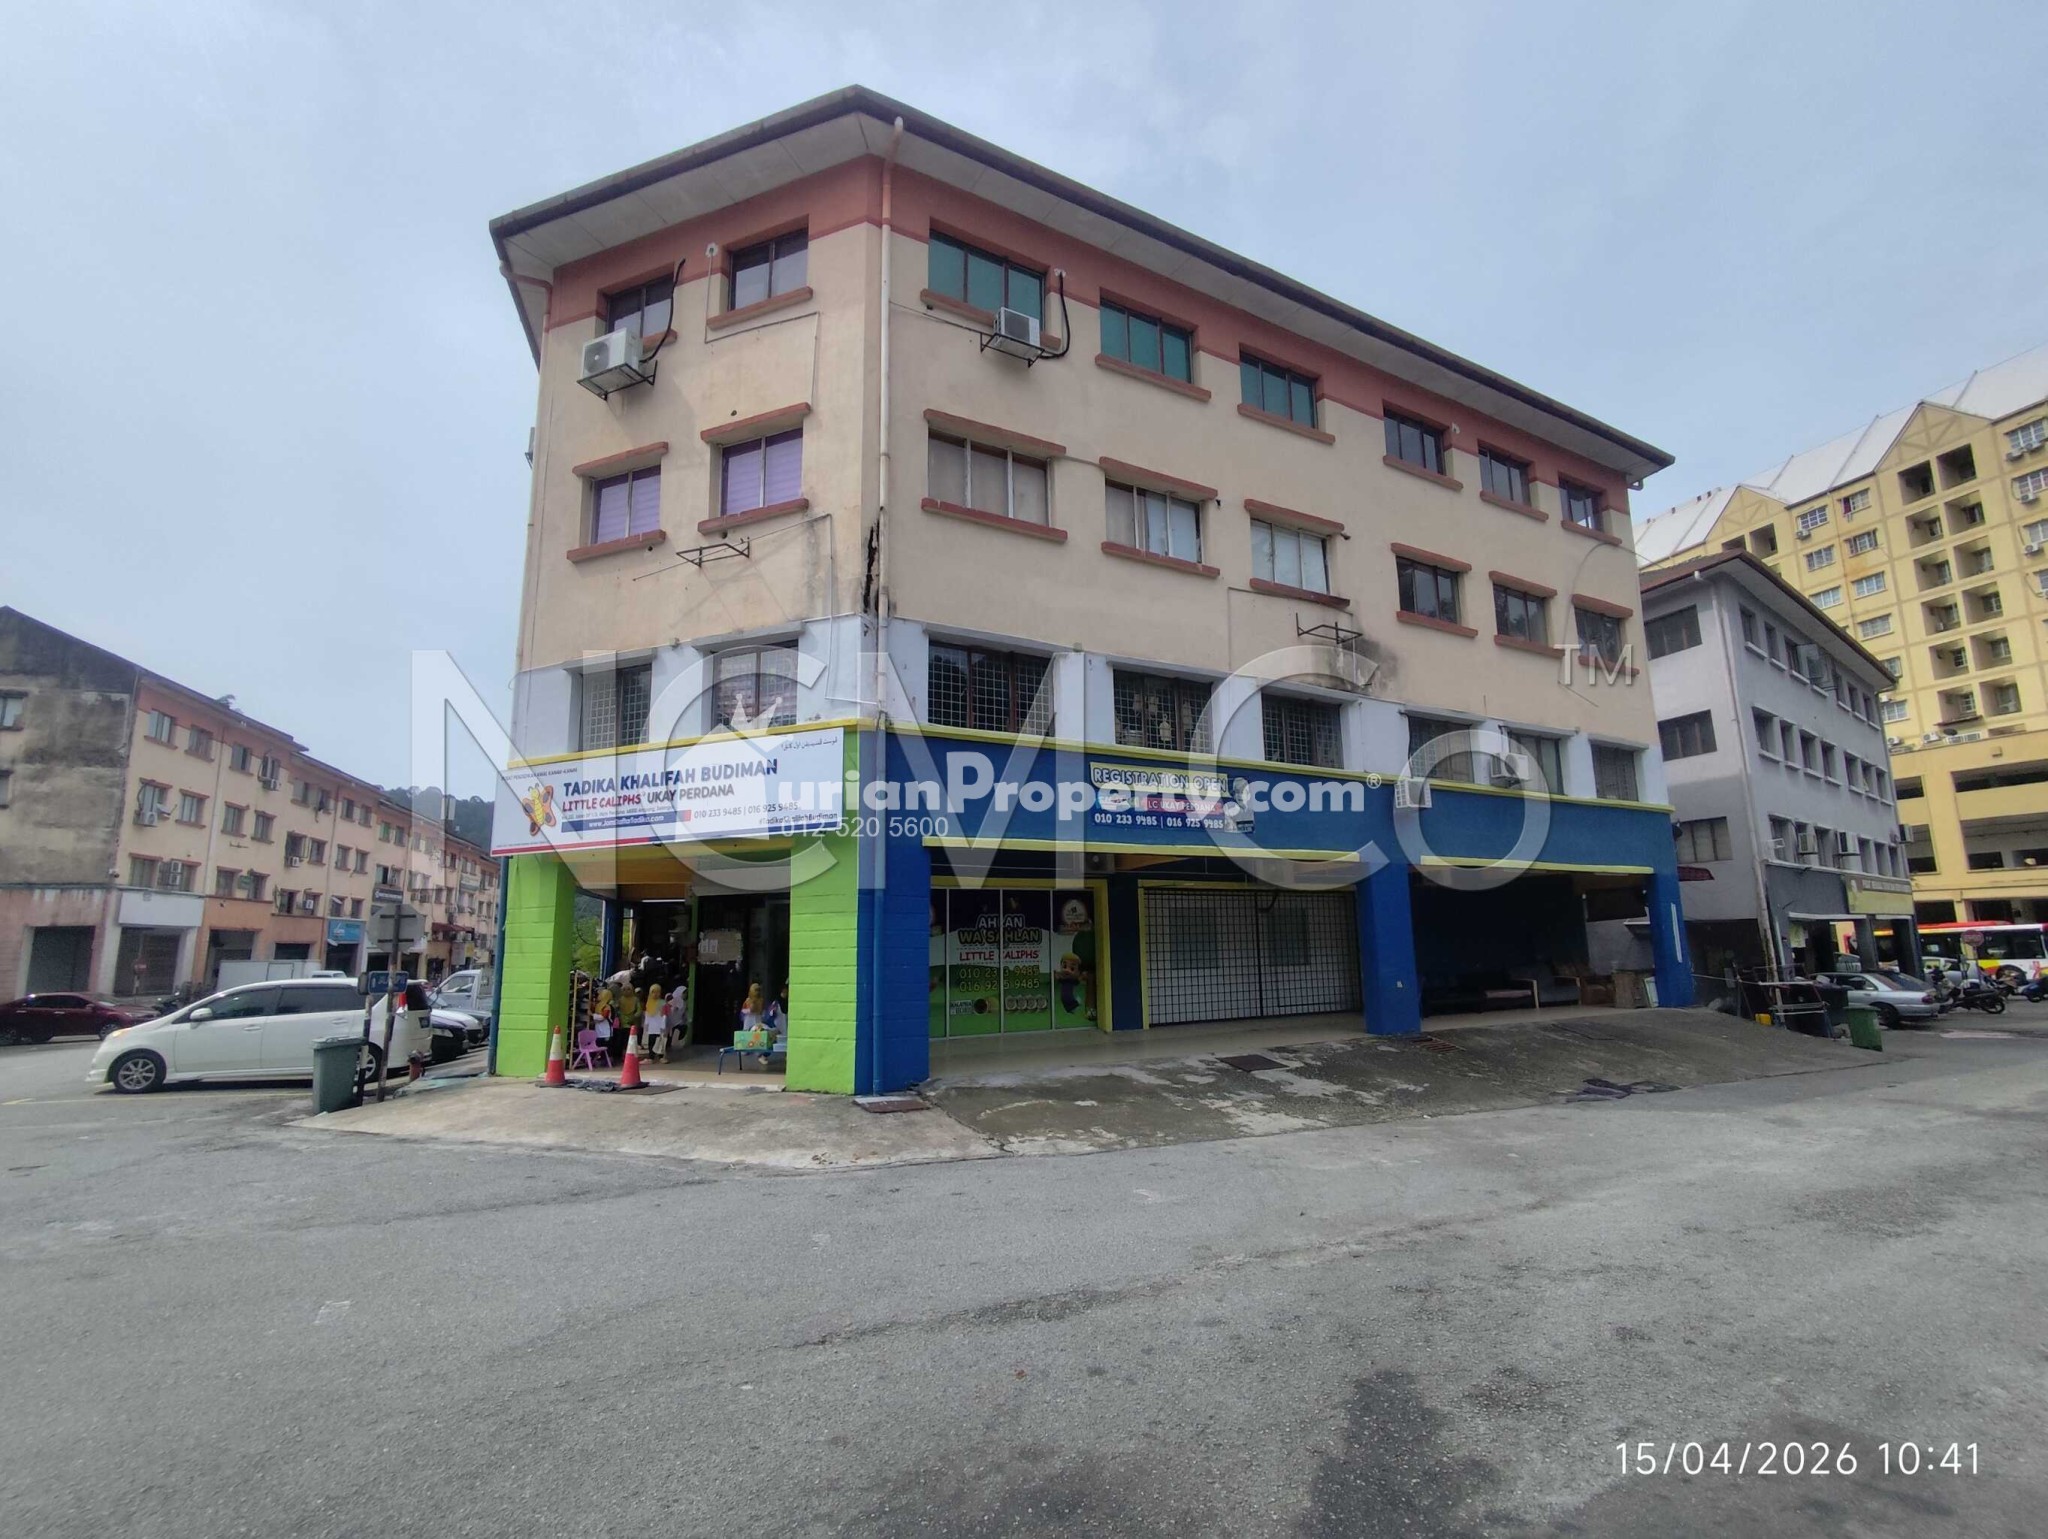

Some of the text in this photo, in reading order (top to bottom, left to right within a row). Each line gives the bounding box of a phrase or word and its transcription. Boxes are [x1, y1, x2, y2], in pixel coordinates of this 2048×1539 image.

[564, 759, 778, 797] TADIKA KHALIFAH BUDIMAN
[1093, 767, 1228, 793] REGISTRATION OPEN
[562, 798, 597, 812] LITTLE
[647, 789, 676, 803] UKAY
[679, 783, 735, 800] PERDANA
[1148, 800, 1158, 809] LC
[694, 810, 707, 819] 010
[708, 809, 722, 818] 233
[723, 807, 743, 817] 9485
[747, 805, 761, 814] 016
[762, 803, 777, 813] 925
[778, 801, 799, 812] 9485
[1094, 813, 1112, 823] 010
[1116, 814, 1133, 825] 233
[1136, 816, 1158, 826] 9485
[1166, 817, 1182, 827] 016
[1185, 818, 1201, 828] 925
[1203, 818, 1224, 829] 9485
[960, 950, 1039, 961] LITTLE ALIPHS
[960, 965, 1040, 979] 010 233 9485
[960, 979, 1040, 993] 016 925 9485
